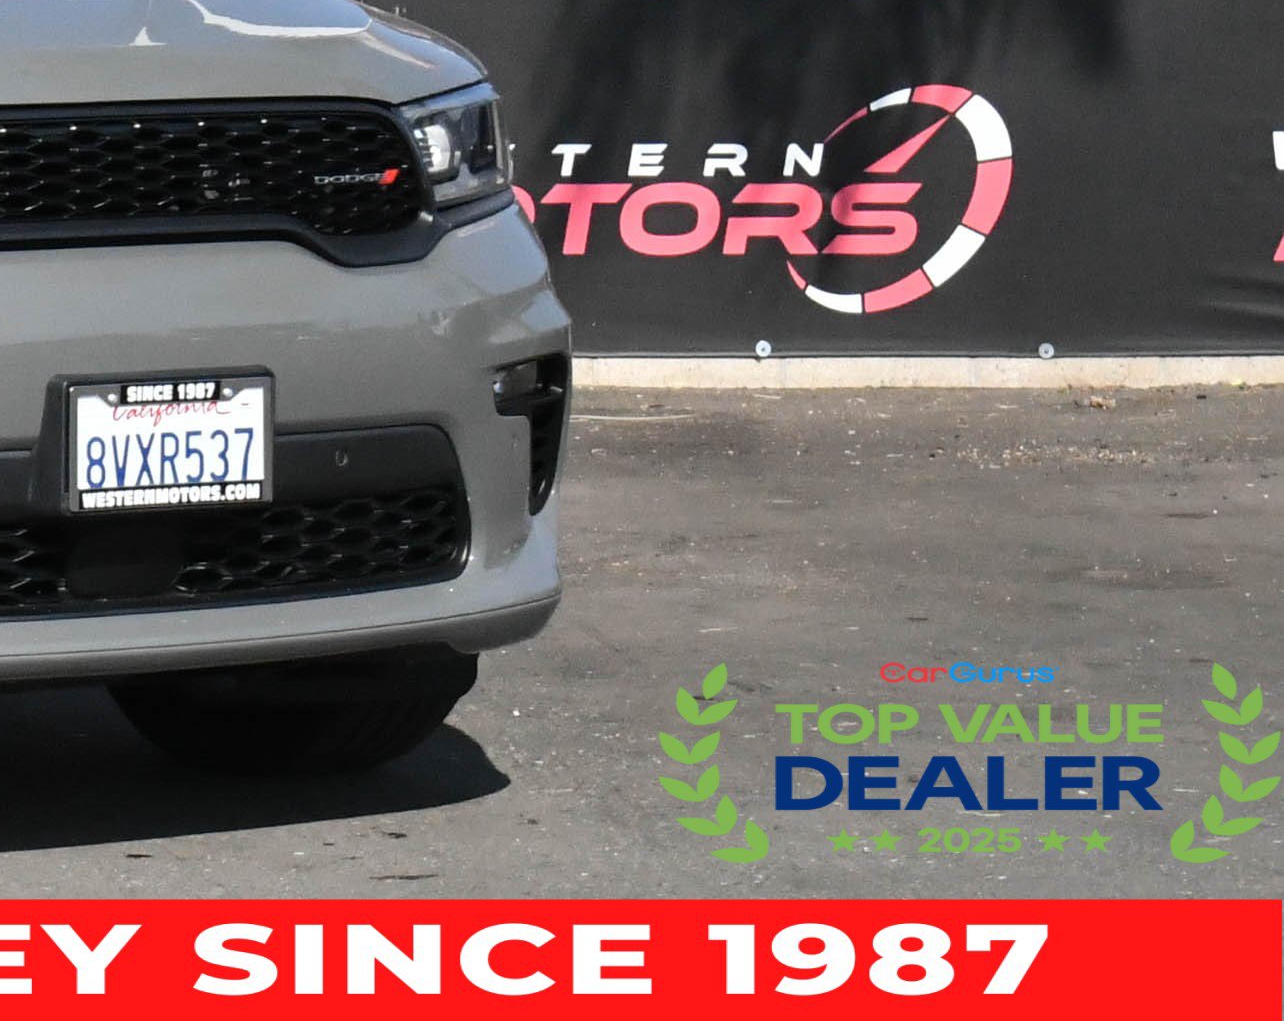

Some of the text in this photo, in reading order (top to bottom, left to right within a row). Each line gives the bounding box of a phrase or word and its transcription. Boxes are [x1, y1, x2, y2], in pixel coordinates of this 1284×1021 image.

[512, 182, 923, 256] TORS
[126, 382, 216, 402] SINCE 1987
[86, 428, 254, 488] 8VXR537
[82, 483, 261, 509] WESTERNMOTORS.COM
